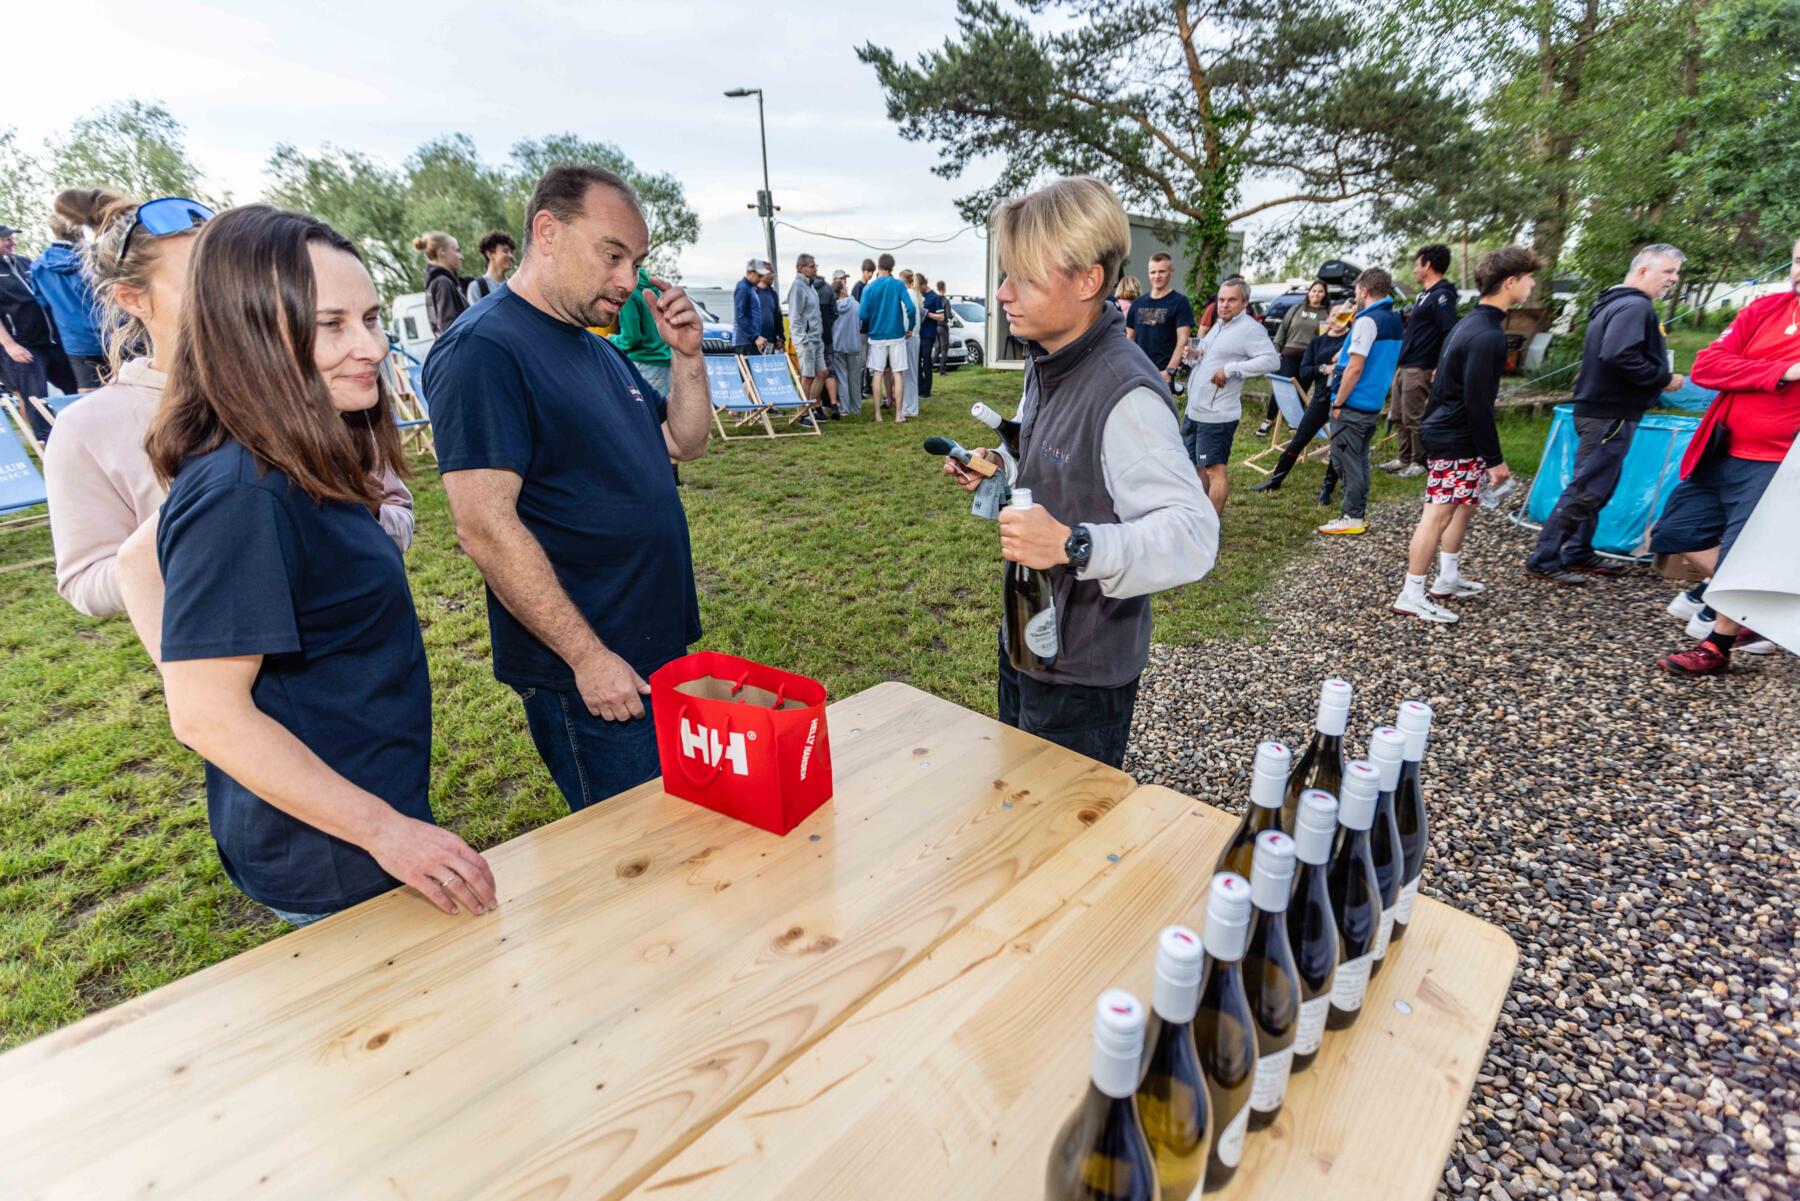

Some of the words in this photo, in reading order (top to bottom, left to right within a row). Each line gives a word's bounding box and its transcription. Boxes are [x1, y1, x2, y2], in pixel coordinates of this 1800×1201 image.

[680, 717, 749, 776] HH
[806, 717, 819, 745] HELLY
[800, 745, 813, 781] HANSEN
